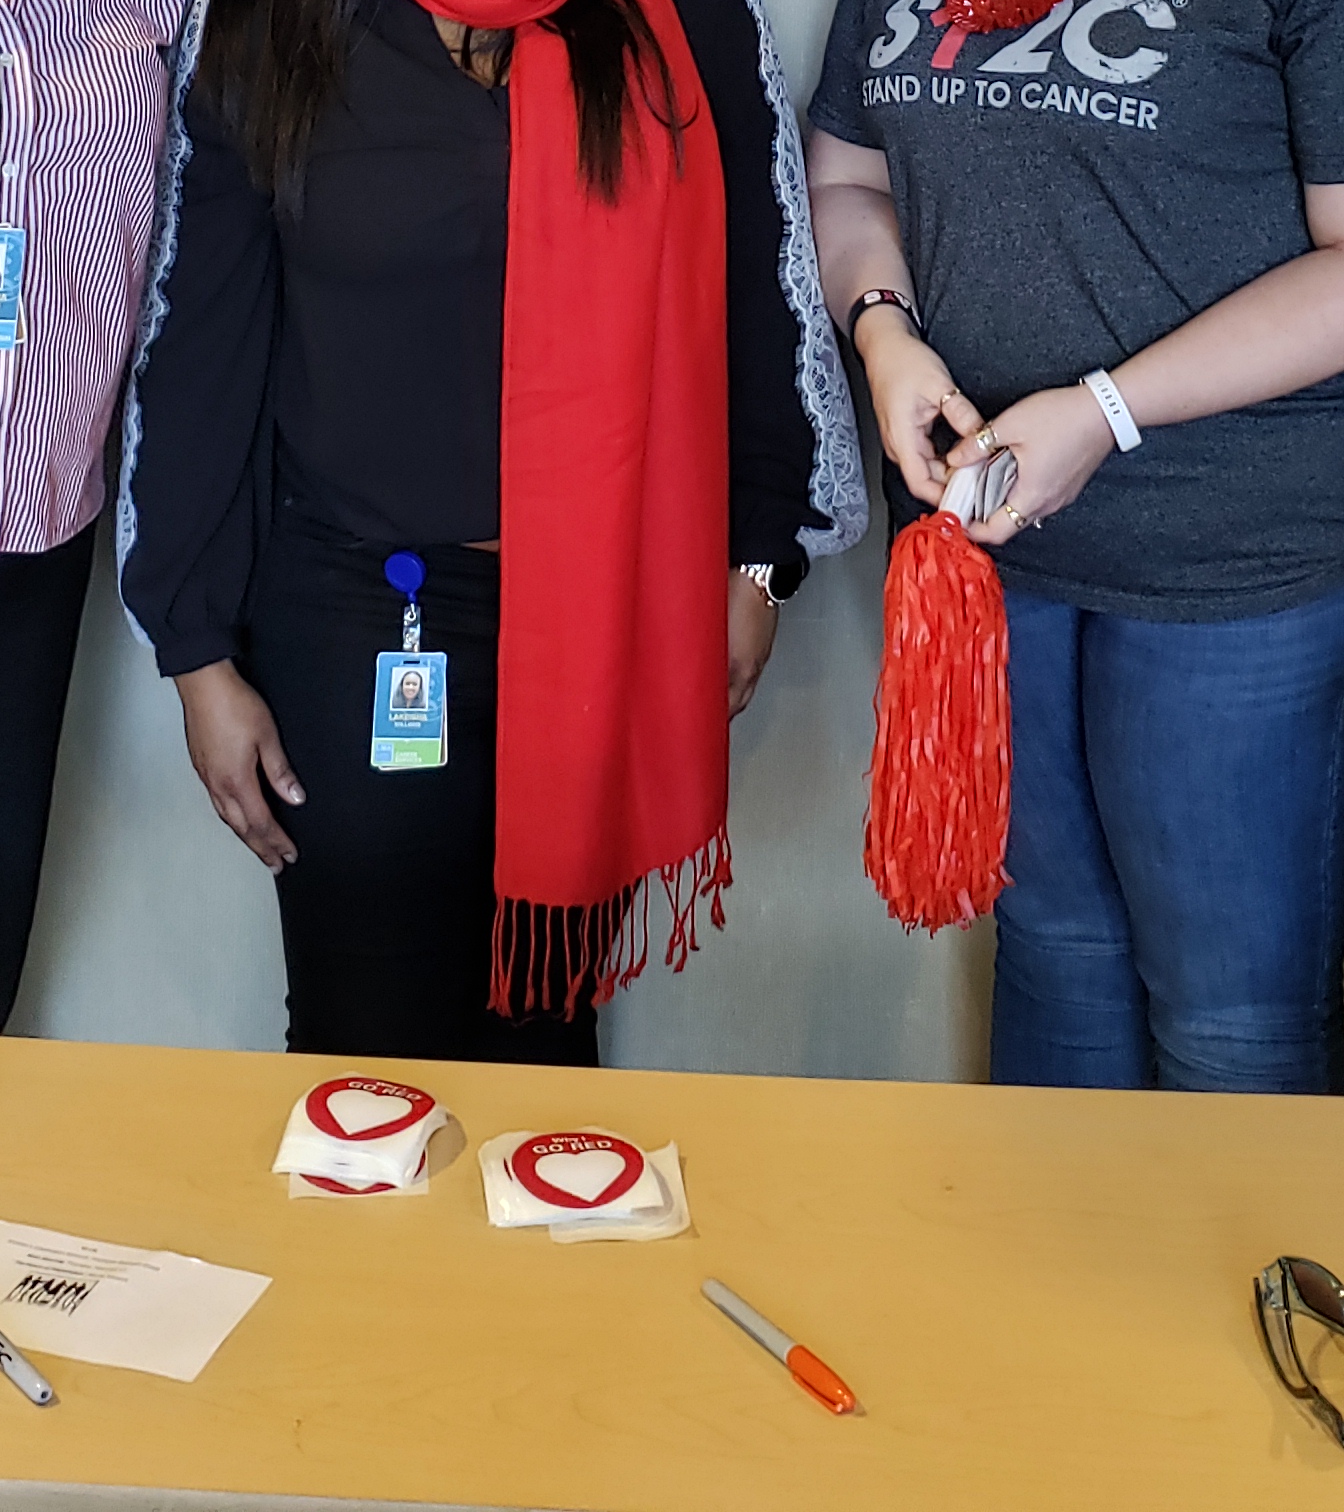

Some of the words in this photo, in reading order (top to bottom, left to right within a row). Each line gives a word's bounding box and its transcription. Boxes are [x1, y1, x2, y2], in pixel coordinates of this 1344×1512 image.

[862, 74, 921, 107] STAND
[931, 76, 965, 104] UP
[975, 80, 1011, 109] TO
[1021, 83, 1159, 130] CANCER
[532, 1144, 563, 1154] GO
[571, 1141, 612, 1151] RED
